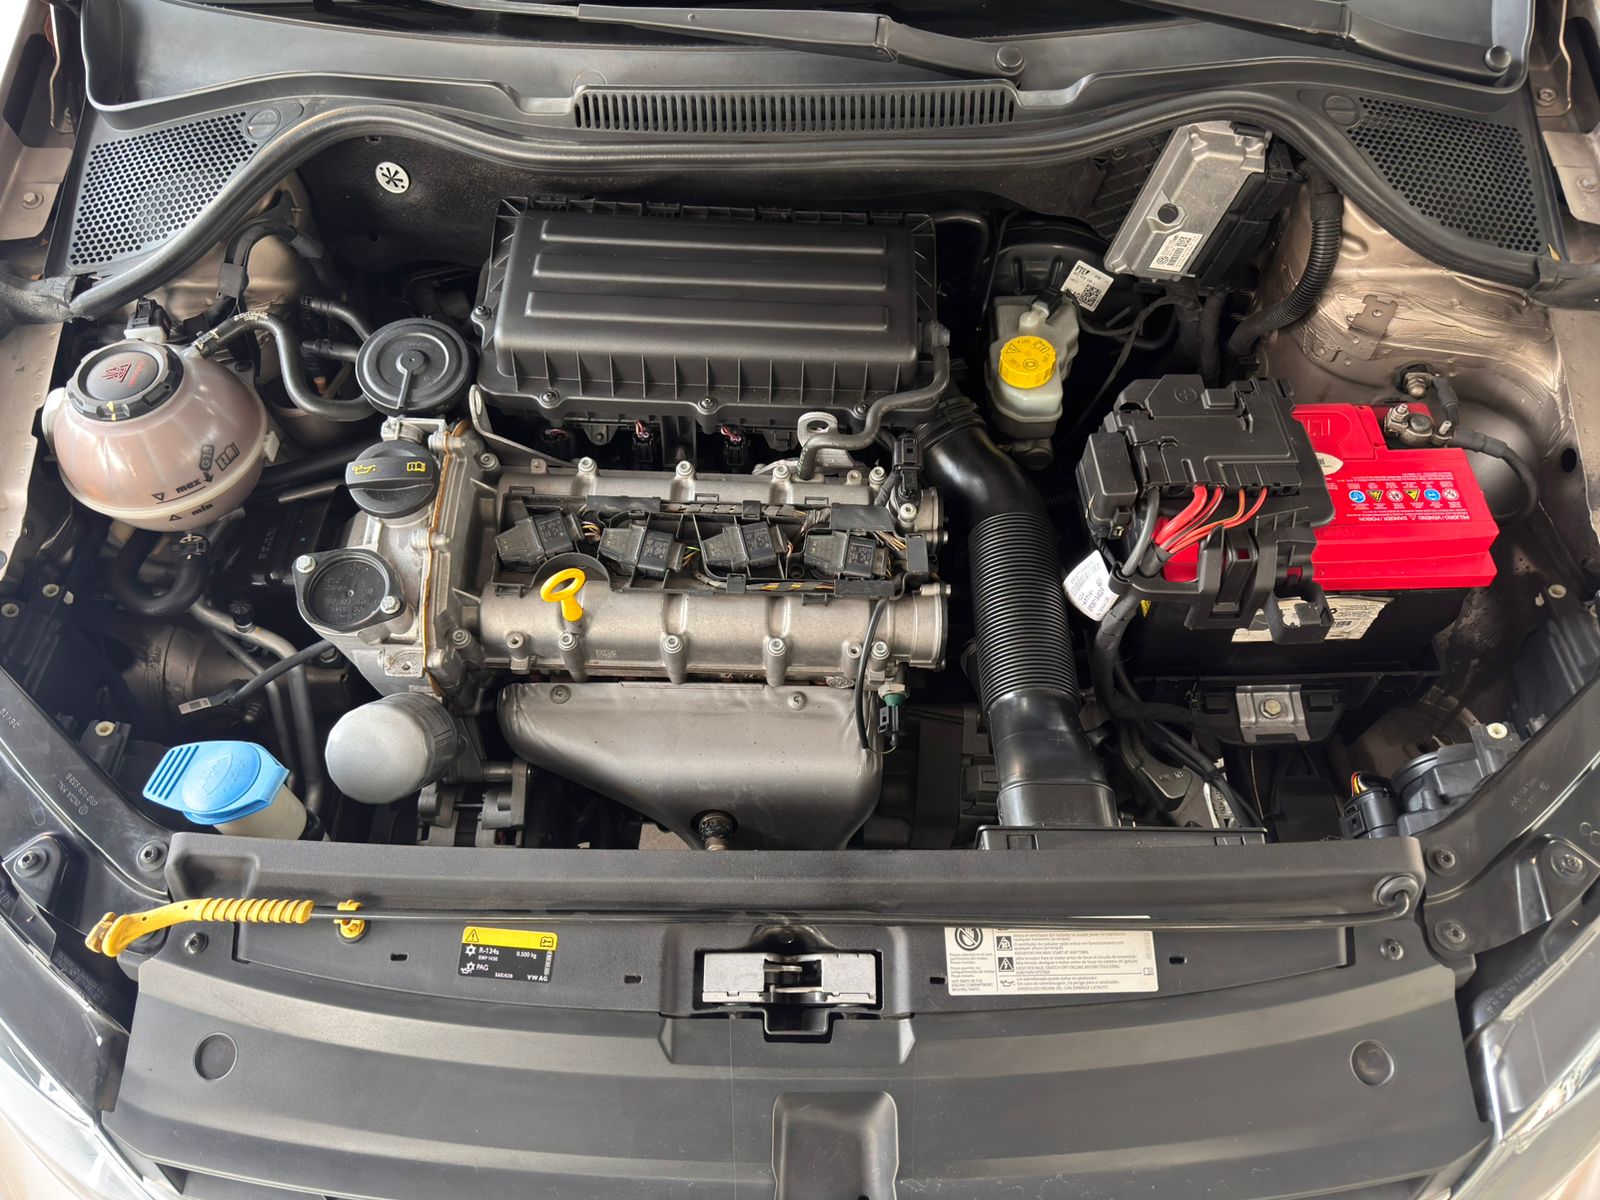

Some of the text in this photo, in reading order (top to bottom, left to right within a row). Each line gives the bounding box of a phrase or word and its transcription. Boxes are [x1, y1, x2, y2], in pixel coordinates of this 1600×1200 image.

[176, 478, 202, 494] max
[191, 503, 213, 516] min
[478, 946, 500, 955] R-134a
